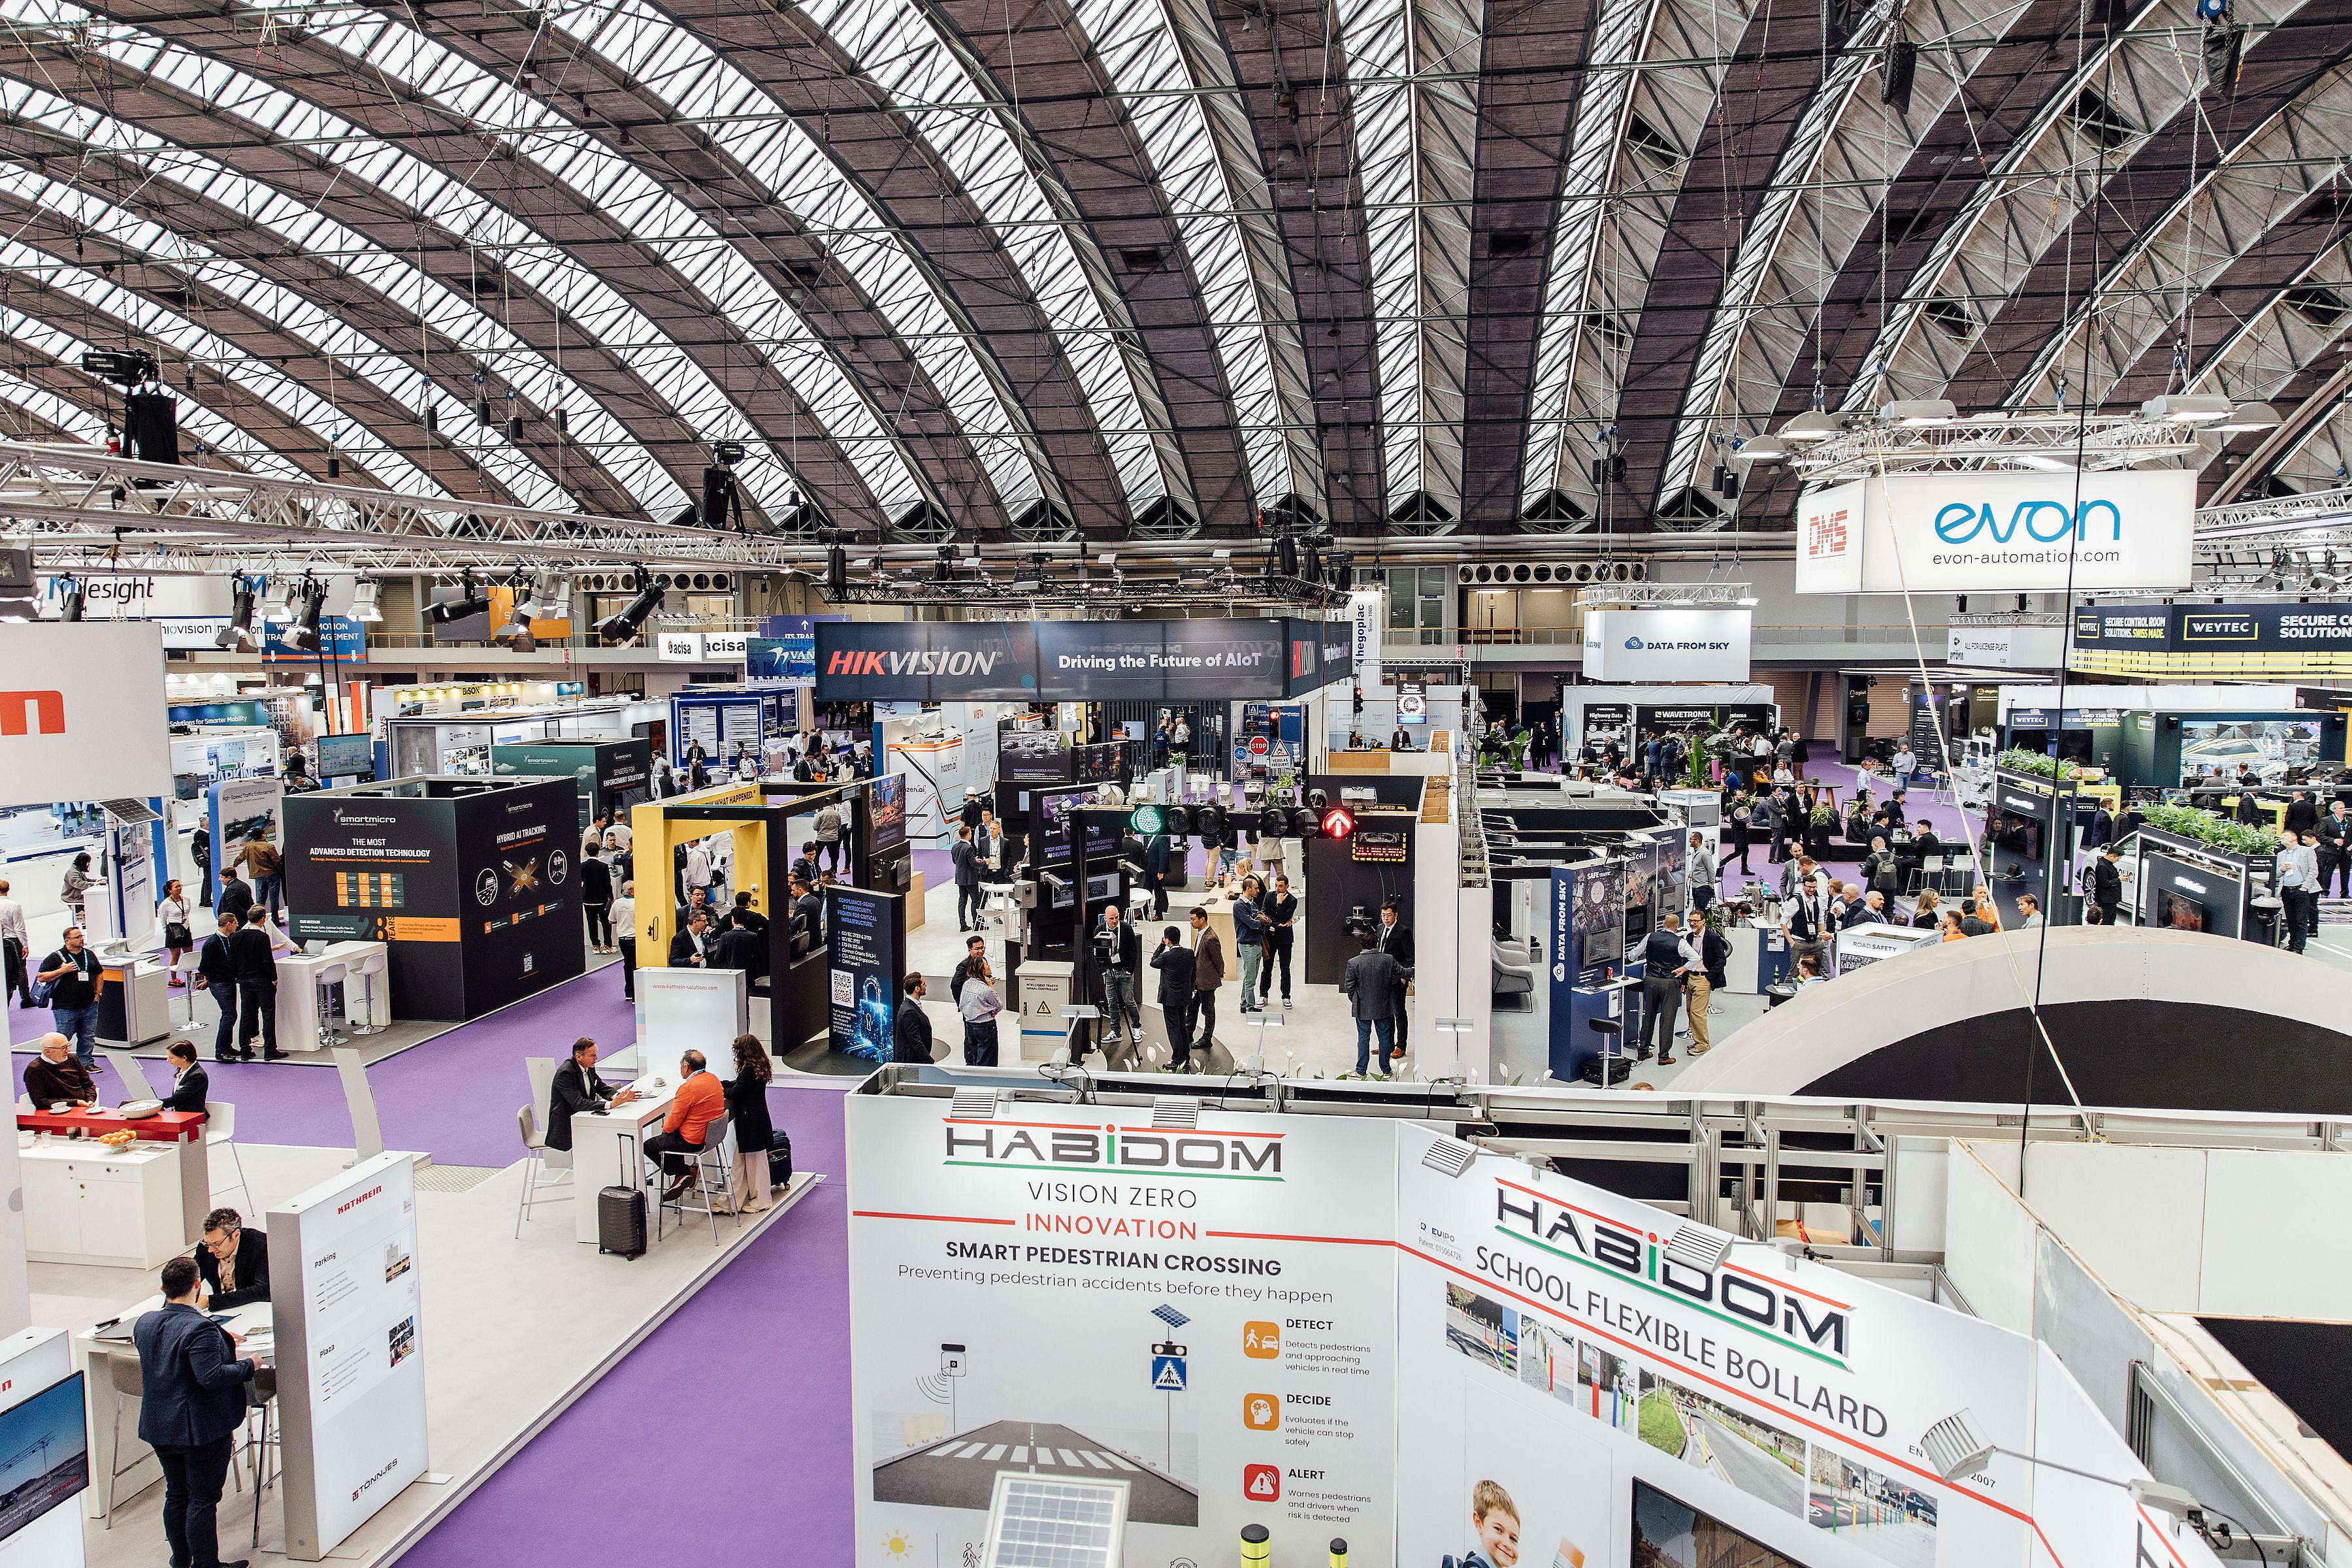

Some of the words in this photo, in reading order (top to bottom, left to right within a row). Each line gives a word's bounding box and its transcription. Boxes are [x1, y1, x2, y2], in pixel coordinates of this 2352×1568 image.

[1935, 499, 2121, 544] evon
[1933, 549, 2119, 564] evon-automation.com
[2080, 623, 2097, 632] WEYTEC
[2105, 617, 2124, 627] SECURE
[2124, 617, 2148, 627] CONTROL
[2149, 616, 2166, 627] ROOM
[2192, 622, 2249, 632] WEYTEC
[2279, 615, 2338, 627] SECURE
[1356, 604, 1367, 657] hegoplac
[2104, 628, 2132, 638] SOLUTIONS.
[2132, 628, 2148, 638] SWISS
[674, 642, 691, 654] acisa
[706, 638, 746, 652] acisa
[1058, 654, 1116, 672] Driving
[1119, 655, 1146, 668] the
[1149, 654, 1201, 668] Future
[1205, 653, 1222, 666] of
[1224, 653, 1262, 666] AIoT
[613, 767, 628, 776] SENSORS
[603, 777, 627, 787] ENFORCEMENT
[627, 772, 645, 783] SOLUTIONS
[713, 795, 728, 805] WHAT
[508, 802, 533, 812] smartmicro
[340, 815, 396, 824] smartmicro
[497, 832, 515, 844] HYBRID
[515, 830, 521, 839] AI
[522, 825, 546, 838] TRACKING
[352, 838, 366, 846] THE
[310, 847, 346, 856] ADVANCED
[347, 848, 384, 857] DETECTION
[385, 849, 431, 857] TECHNOLOGY
[1587, 871, 1599, 880] SAFE
[838, 897, 875, 909] COMPLIANCE-READY
[860, 913, 877, 922] CRITICAL
[1853, 941, 1871, 949] ROAD
[1028, 1181, 1117, 1205] VISION
[1130, 1188, 1197, 1209] ZERO
[1026, 1213, 1197, 1241] INNOVATION
[1431, 1227, 1455, 1242] EUIPO
[1418, 1236, 1435, 1250] Patent:
[314, 1252, 336, 1269] Parking
[945, 1240, 1020, 1262] SMART
[1026, 1246, 1158, 1270] PEDESTRIAN
[1164, 1253, 1282, 1277] CROSSING
[898, 1263, 986, 1285] Preventing
[990, 1268, 1077, 1288] pedestrian
[1081, 1274, 1162, 1294] accidents
[1166, 1280, 1220, 1297] before
[1225, 1282, 1262, 1302] they
[1266, 1288, 1333, 1305] happen
[1286, 1318, 1333, 1330] DETECT
[1285, 1341, 1318, 1349] Detects
[1320, 1343, 1371, 1353] pedestrians
[1476, 1245, 1578, 1311] SCHOOL
[1588, 1291, 1716, 1369] FLEXIBLE
[1727, 1358, 1888, 1440] BOLLARD
[319, 1344, 335, 1359] Plaza
[1304, 1354, 1360, 1365] approaching
[1285, 1364, 1320, 1372] vehicles
[1286, 1394, 1331, 1406] DECIDE
[1285, 1415, 1326, 1425] Evaluates
[1335, 1418, 1349, 1427] the
[1285, 1427, 1315, 1435] vehicle
[1335, 1429, 1354, 1440] stop
[1285, 1438, 1310, 1447] safely
[1908, 1445, 1923, 1458] EN
[1288, 1468, 1325, 1480] ALERT
[1288, 1490, 1320, 1499] Warnes
[1322, 1492, 1371, 1503] pedestrians
[1307, 1501, 1335, 1511] drivers
[1337, 1504, 1360, 1513] when
[1288, 1511, 1302, 1520] risk
[1312, 1513, 1350, 1523] detected
